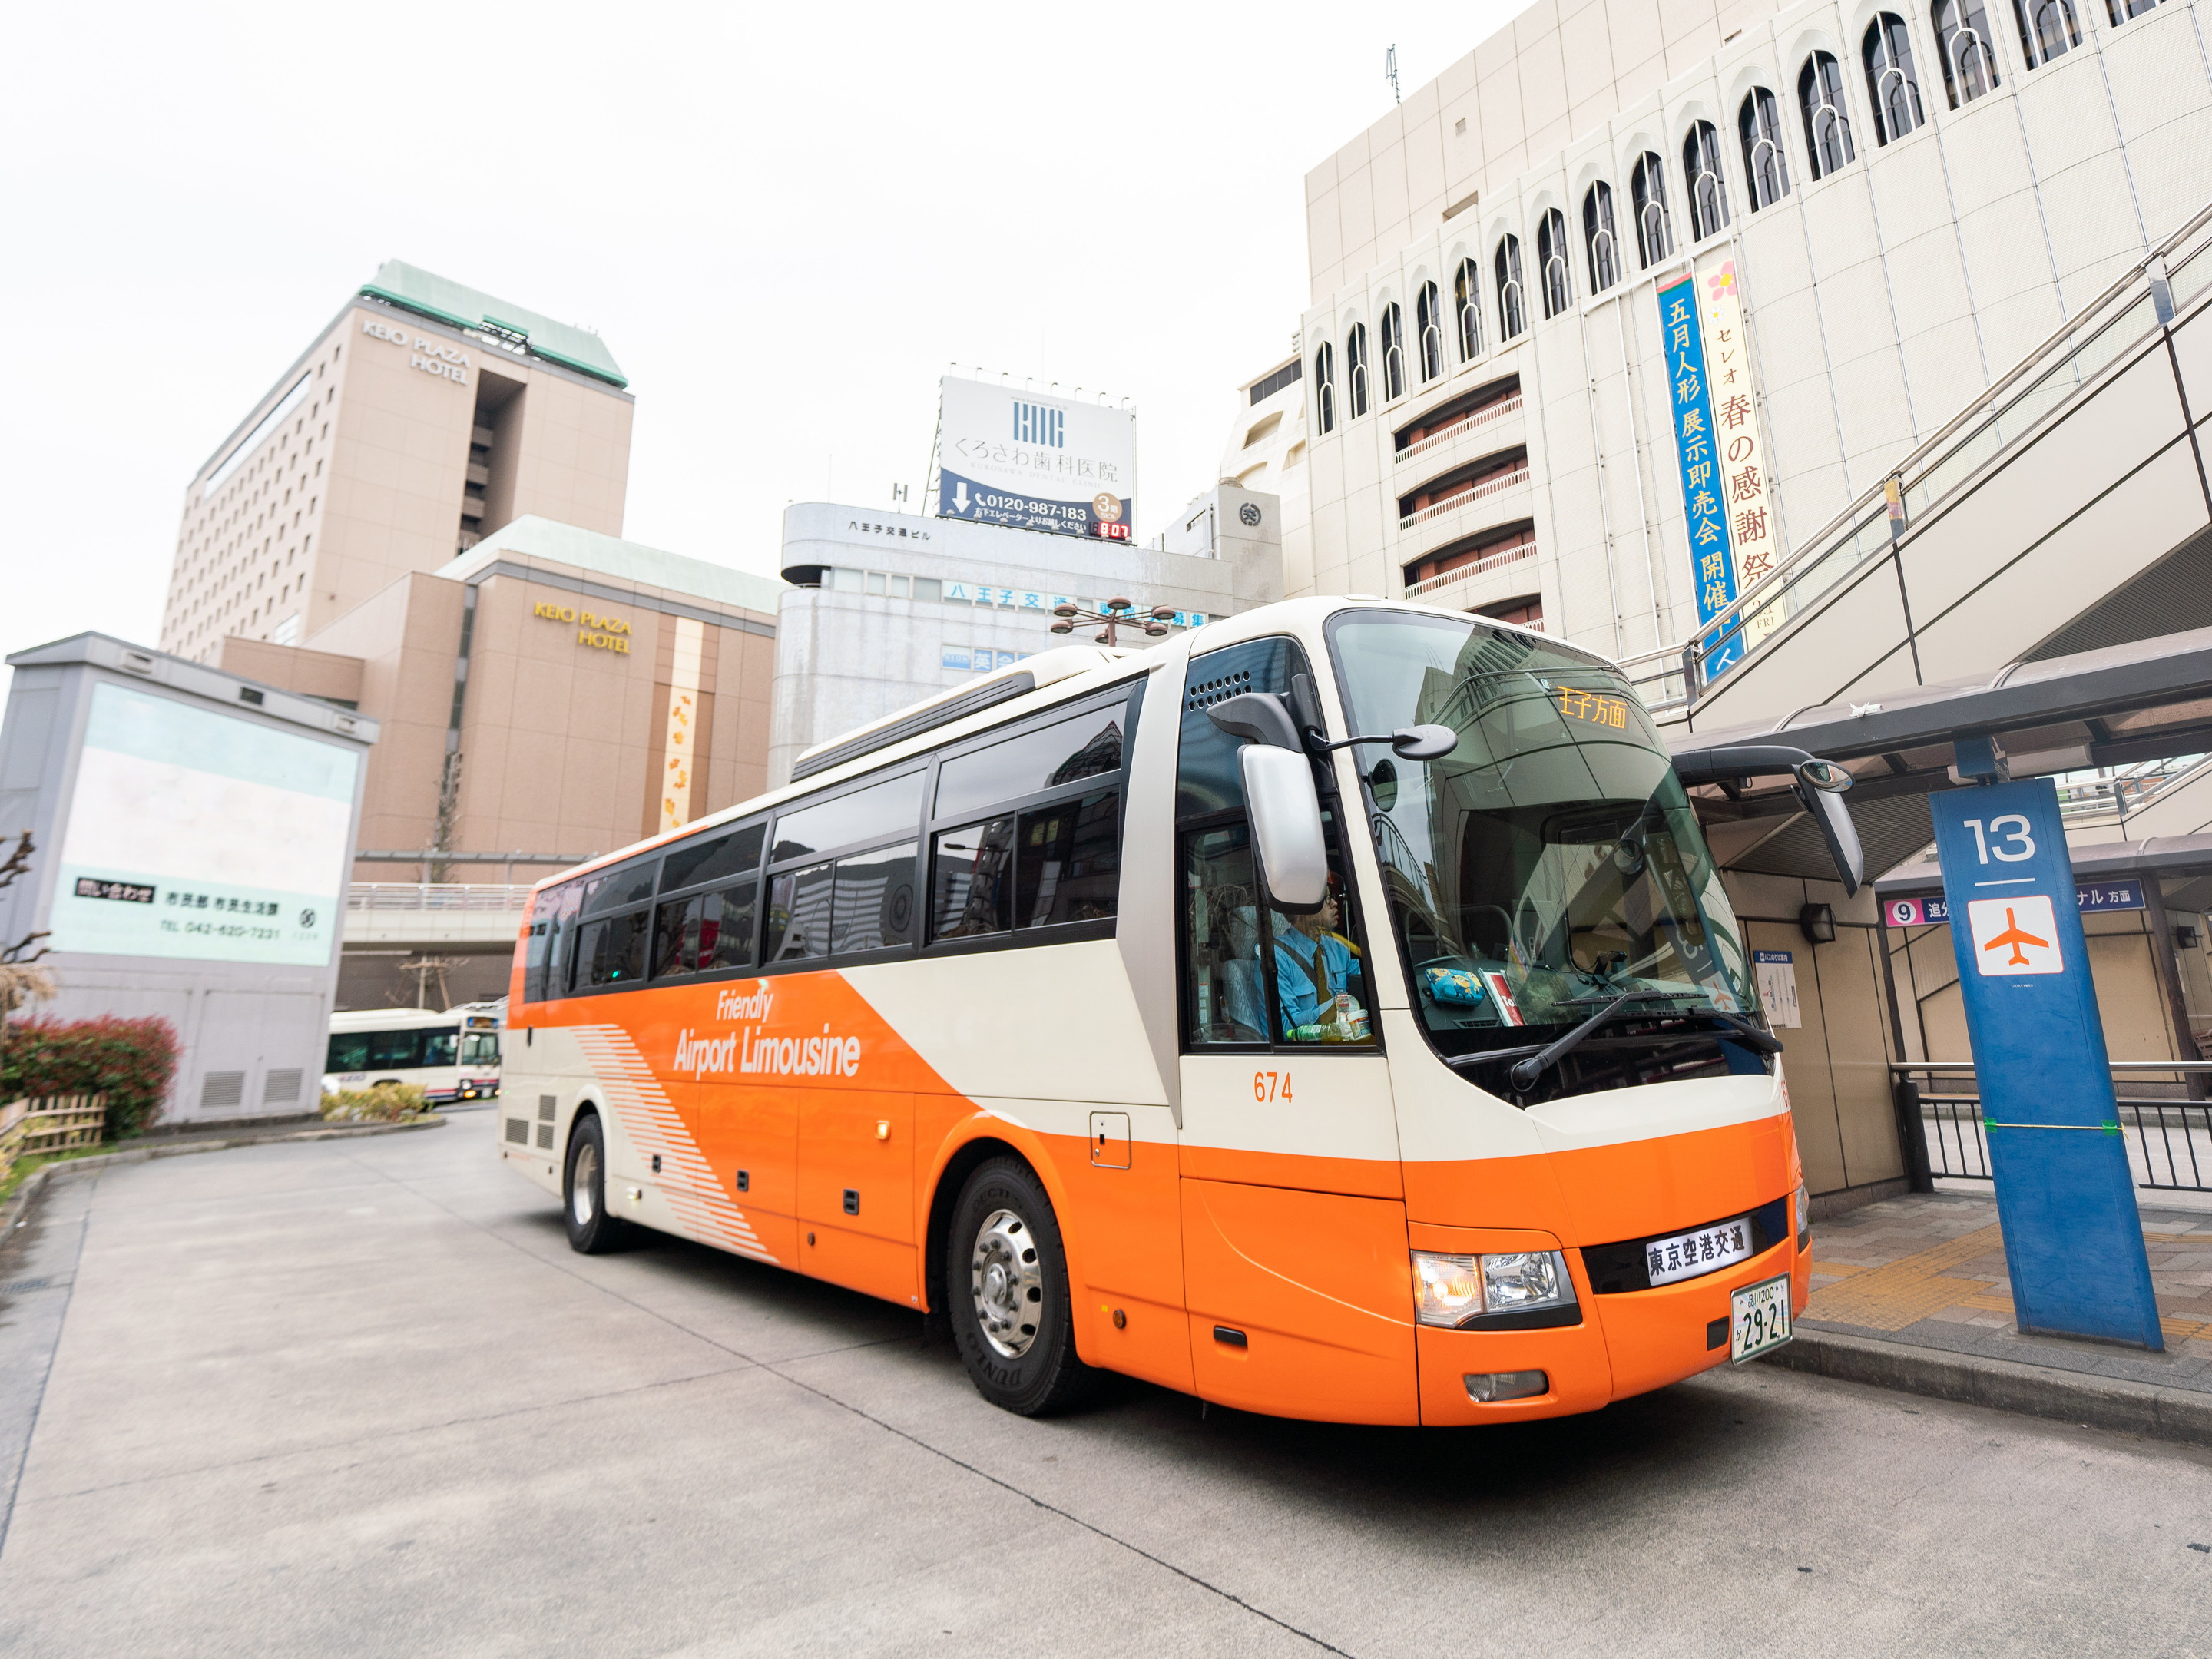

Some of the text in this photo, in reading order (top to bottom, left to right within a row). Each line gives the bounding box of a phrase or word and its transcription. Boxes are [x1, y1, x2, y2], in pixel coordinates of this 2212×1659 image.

[363, 320, 471, 369] KEIO PLAZA
[1668, 298, 1700, 405] 五月人形
[410, 353, 469, 386] HOTEL
[955, 438, 1118, 482] くろさわ歯科医院
[970, 461, 1103, 489] KUROSAWA DENTAL CLINIC
[1682, 408, 1721, 545] 展示即売会
[986, 494, 1087, 522] 0120-987-183
[849, 522, 931, 540] 八王子交通ビル
[534, 601, 631, 635] KEIO PLAZA
[1099, 602, 1204, 627] 乗務募集
[1757, 616, 1775, 629] FRI
[578, 631, 631, 654] HOTEL
[1558, 685, 1628, 729] 王子方面
[1963, 814, 2036, 865] 13
[1897, 903, 1912, 922] 9
[2108, 889, 2131, 903] 方面
[160, 919, 180, 932] TEL
[716, 988, 774, 1024] Friendly
[673, 1022, 862, 1081] Airport Limousine
[1253, 1071, 1293, 1104] 674
[1648, 1224, 1746, 1277] 東京空港交通
[1735, 1329, 1742, 1342] か
[1743, 1299, 1785, 1351] 29-21
